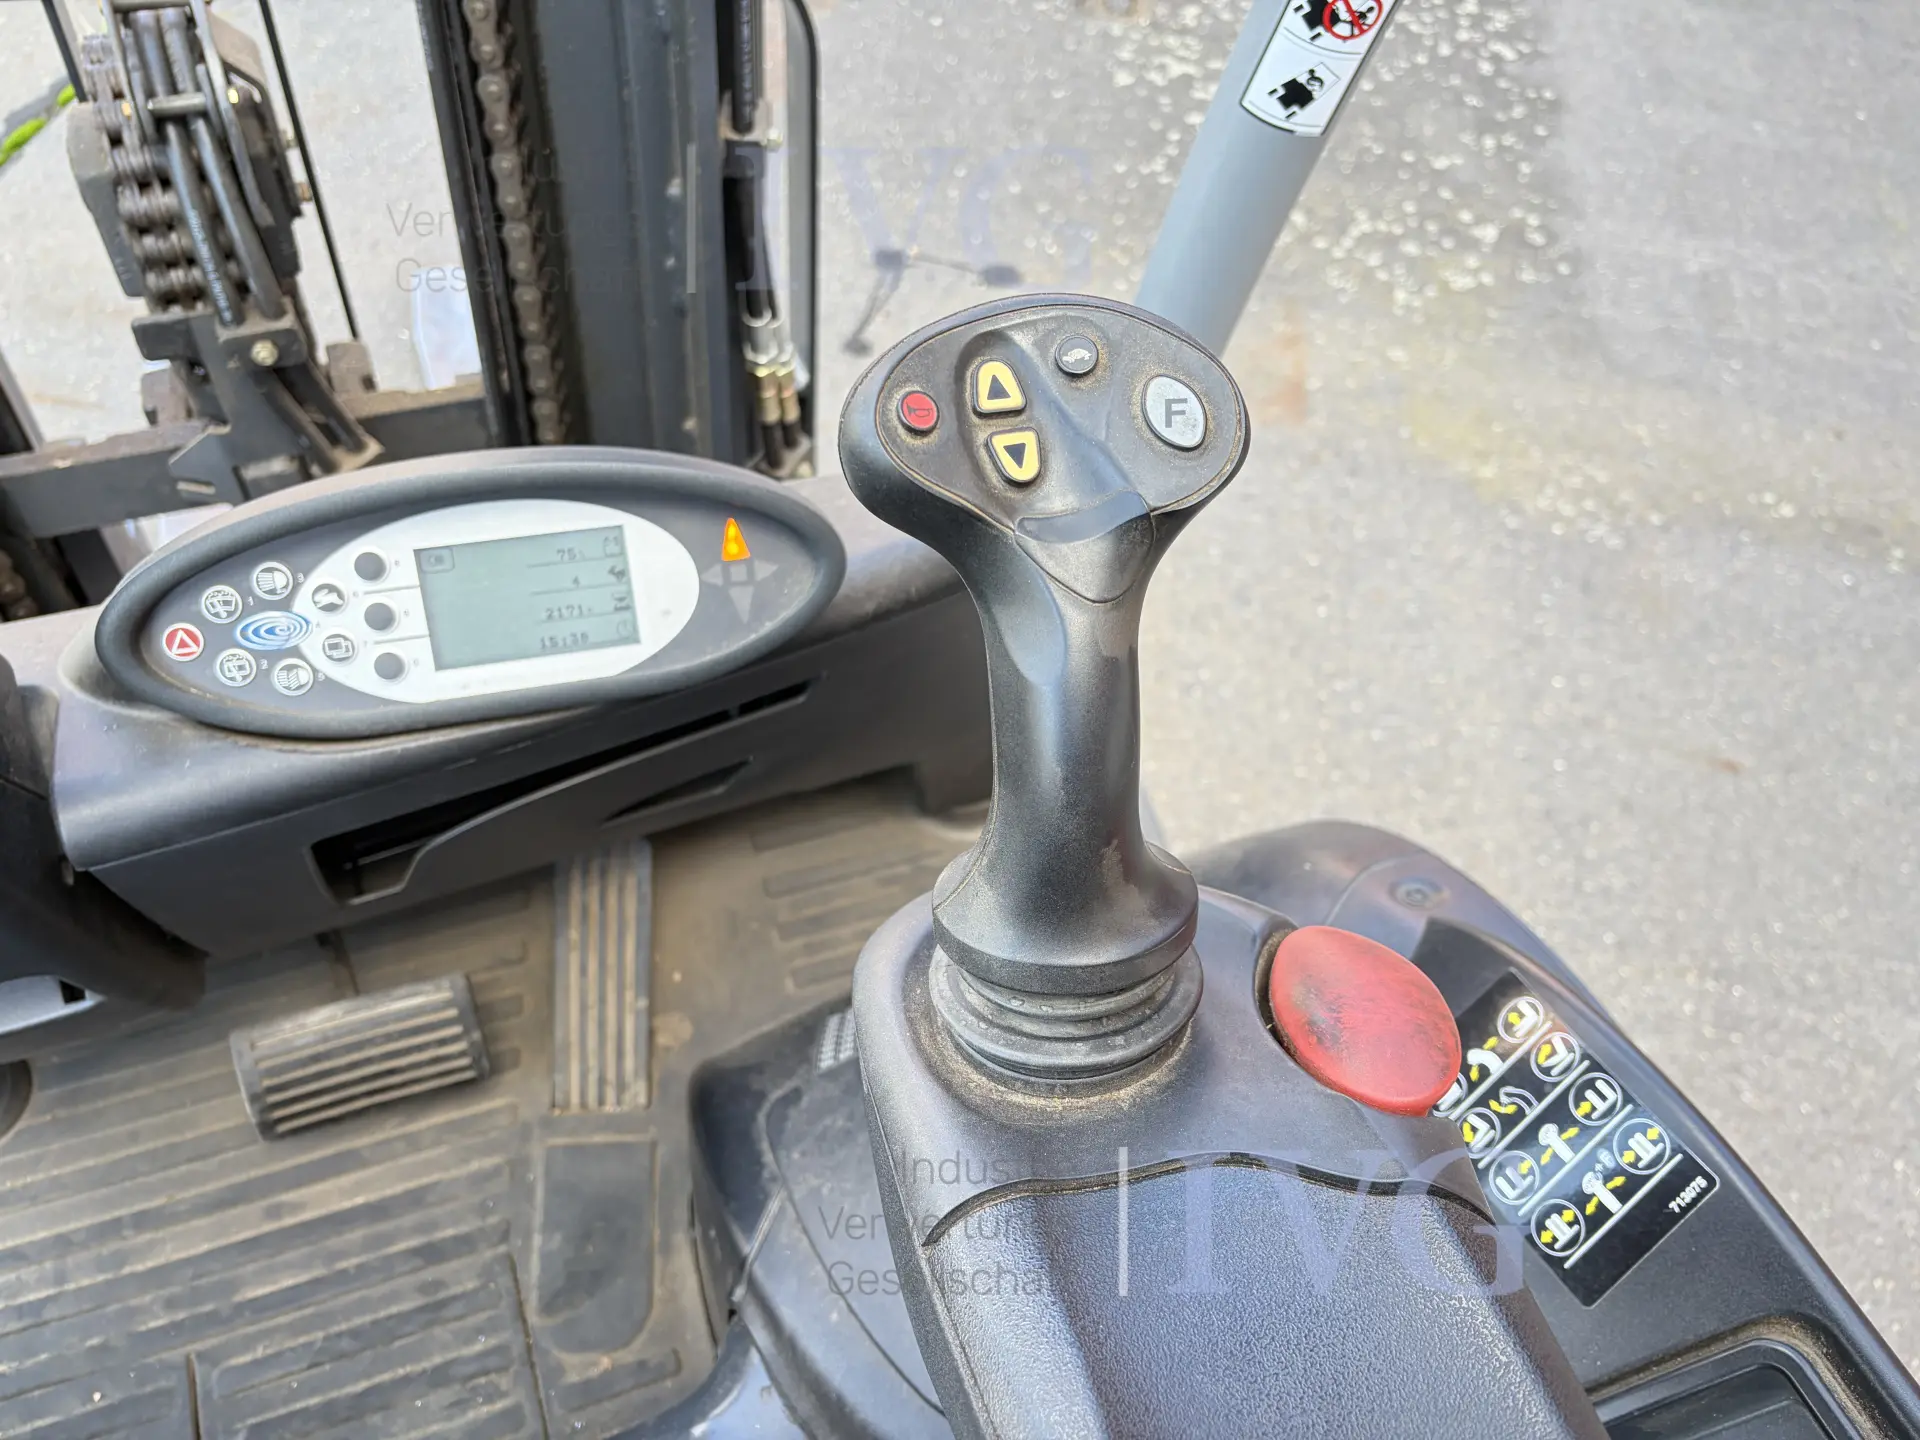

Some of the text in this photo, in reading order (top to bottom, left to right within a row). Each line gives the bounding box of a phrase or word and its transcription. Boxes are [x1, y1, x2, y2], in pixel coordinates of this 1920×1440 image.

[1164, 397, 1188, 429] F
[296, 571, 305, 584] 3
[247, 595, 254, 607] 1
[259, 657, 268, 670] 2
[1667, 1174, 1709, 1215] 713075
